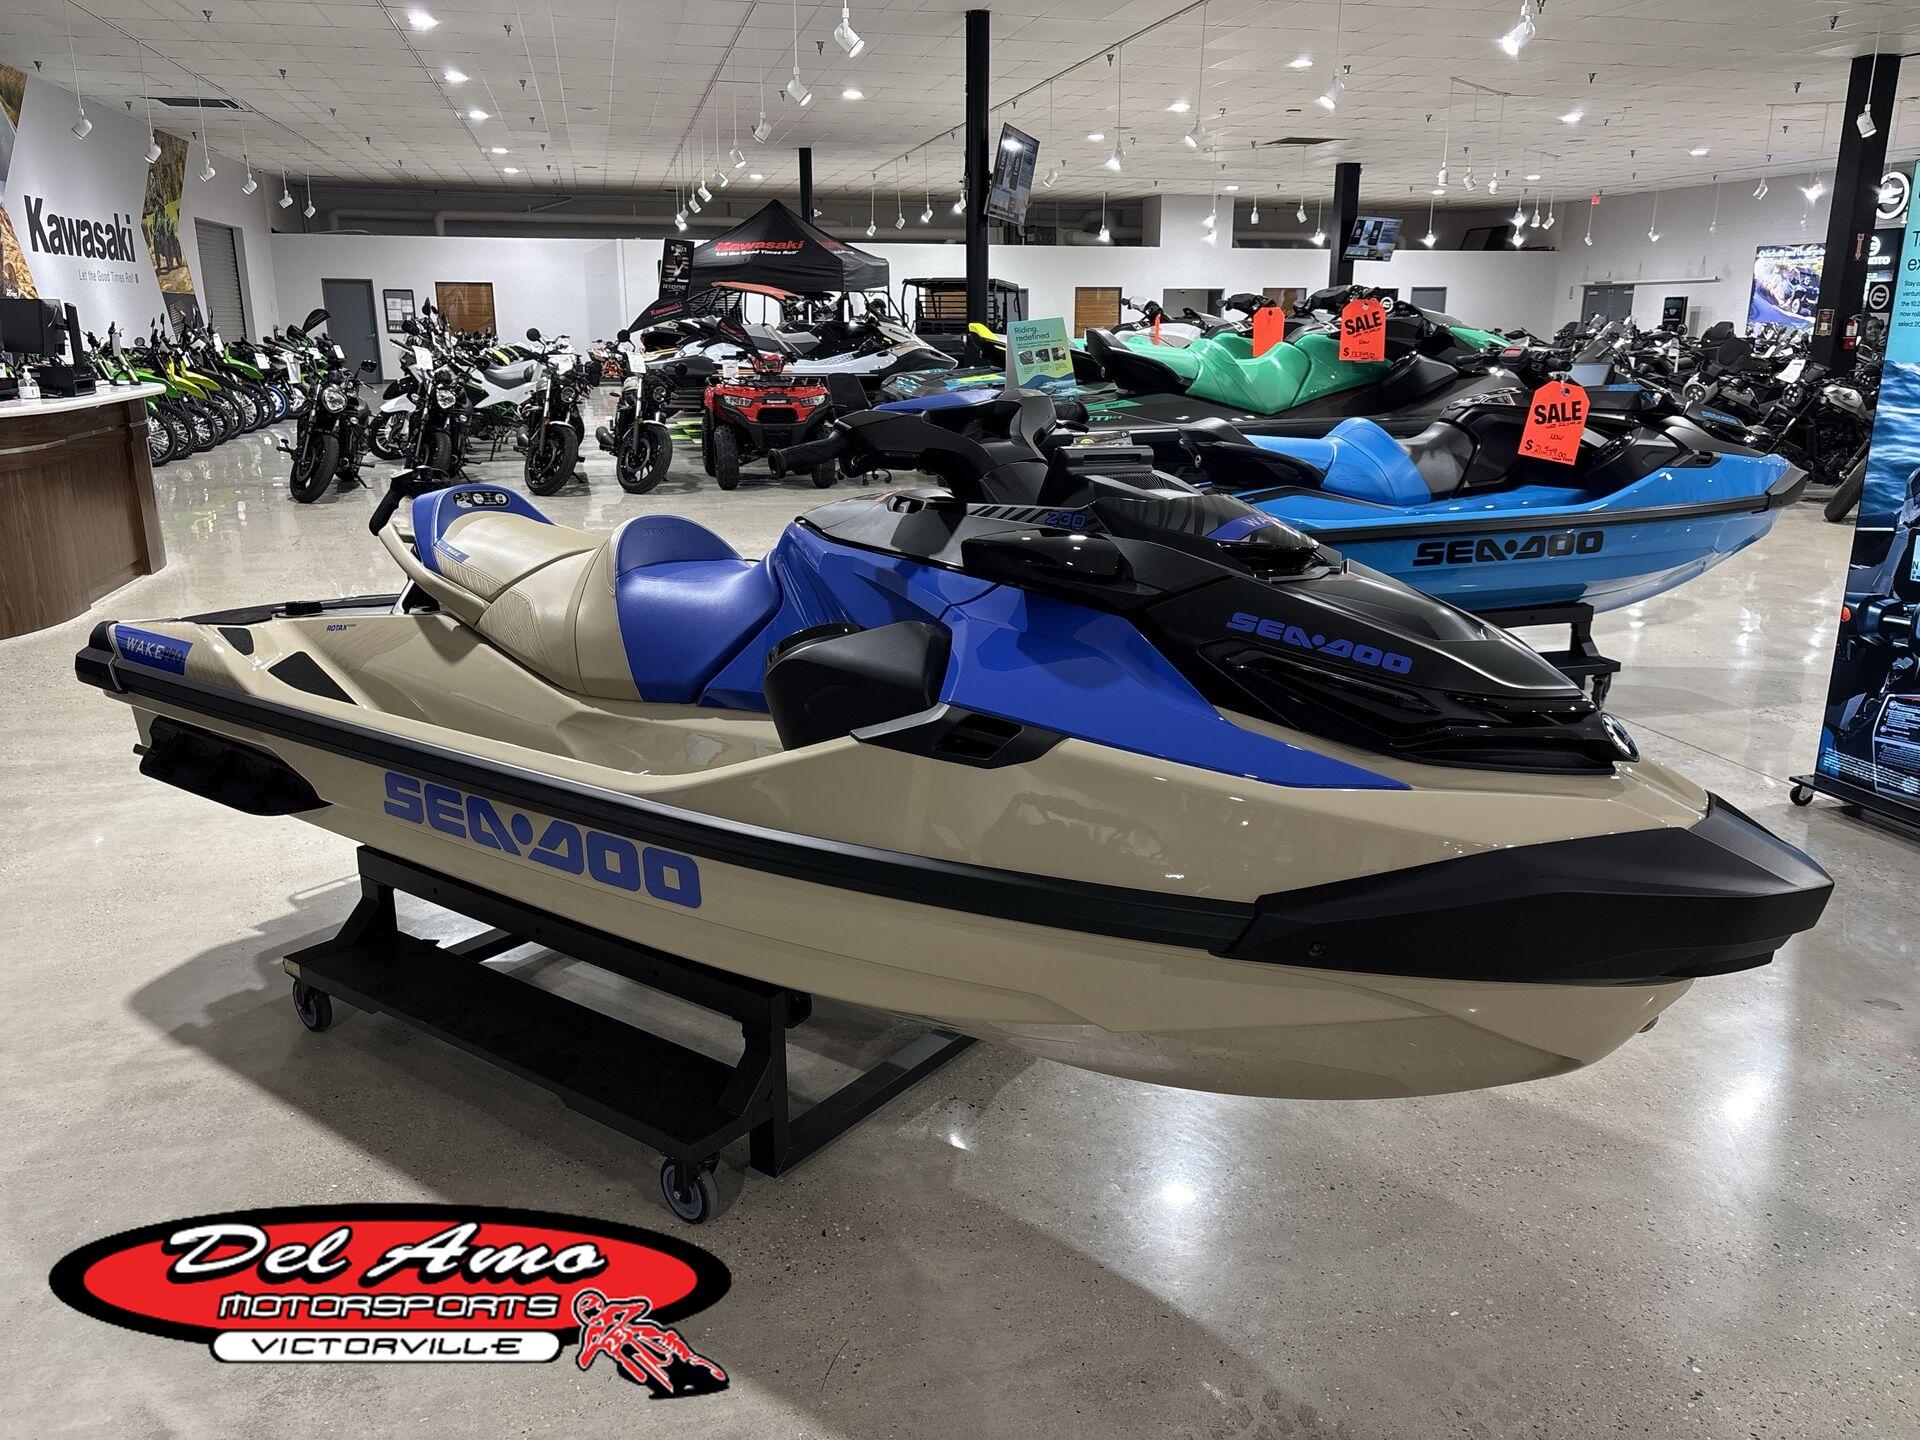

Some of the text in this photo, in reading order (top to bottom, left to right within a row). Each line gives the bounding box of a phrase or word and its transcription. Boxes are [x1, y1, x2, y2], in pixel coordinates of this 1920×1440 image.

[24, 194, 136, 263] Kawasaki
[714, 240, 805, 252] Kawasaki
[79, 269, 88, 281] Let
[97, 270, 110, 282] Good
[1344, 311, 1382, 336] SALE
[1015, 331, 1050, 342] redefined
[1343, 347, 1349, 357] $
[1534, 401, 1582, 425] SALE
[1525, 439, 1533, 451] $
[1046, 511, 1086, 528] 230
[126, 637, 165, 659] WAKE
